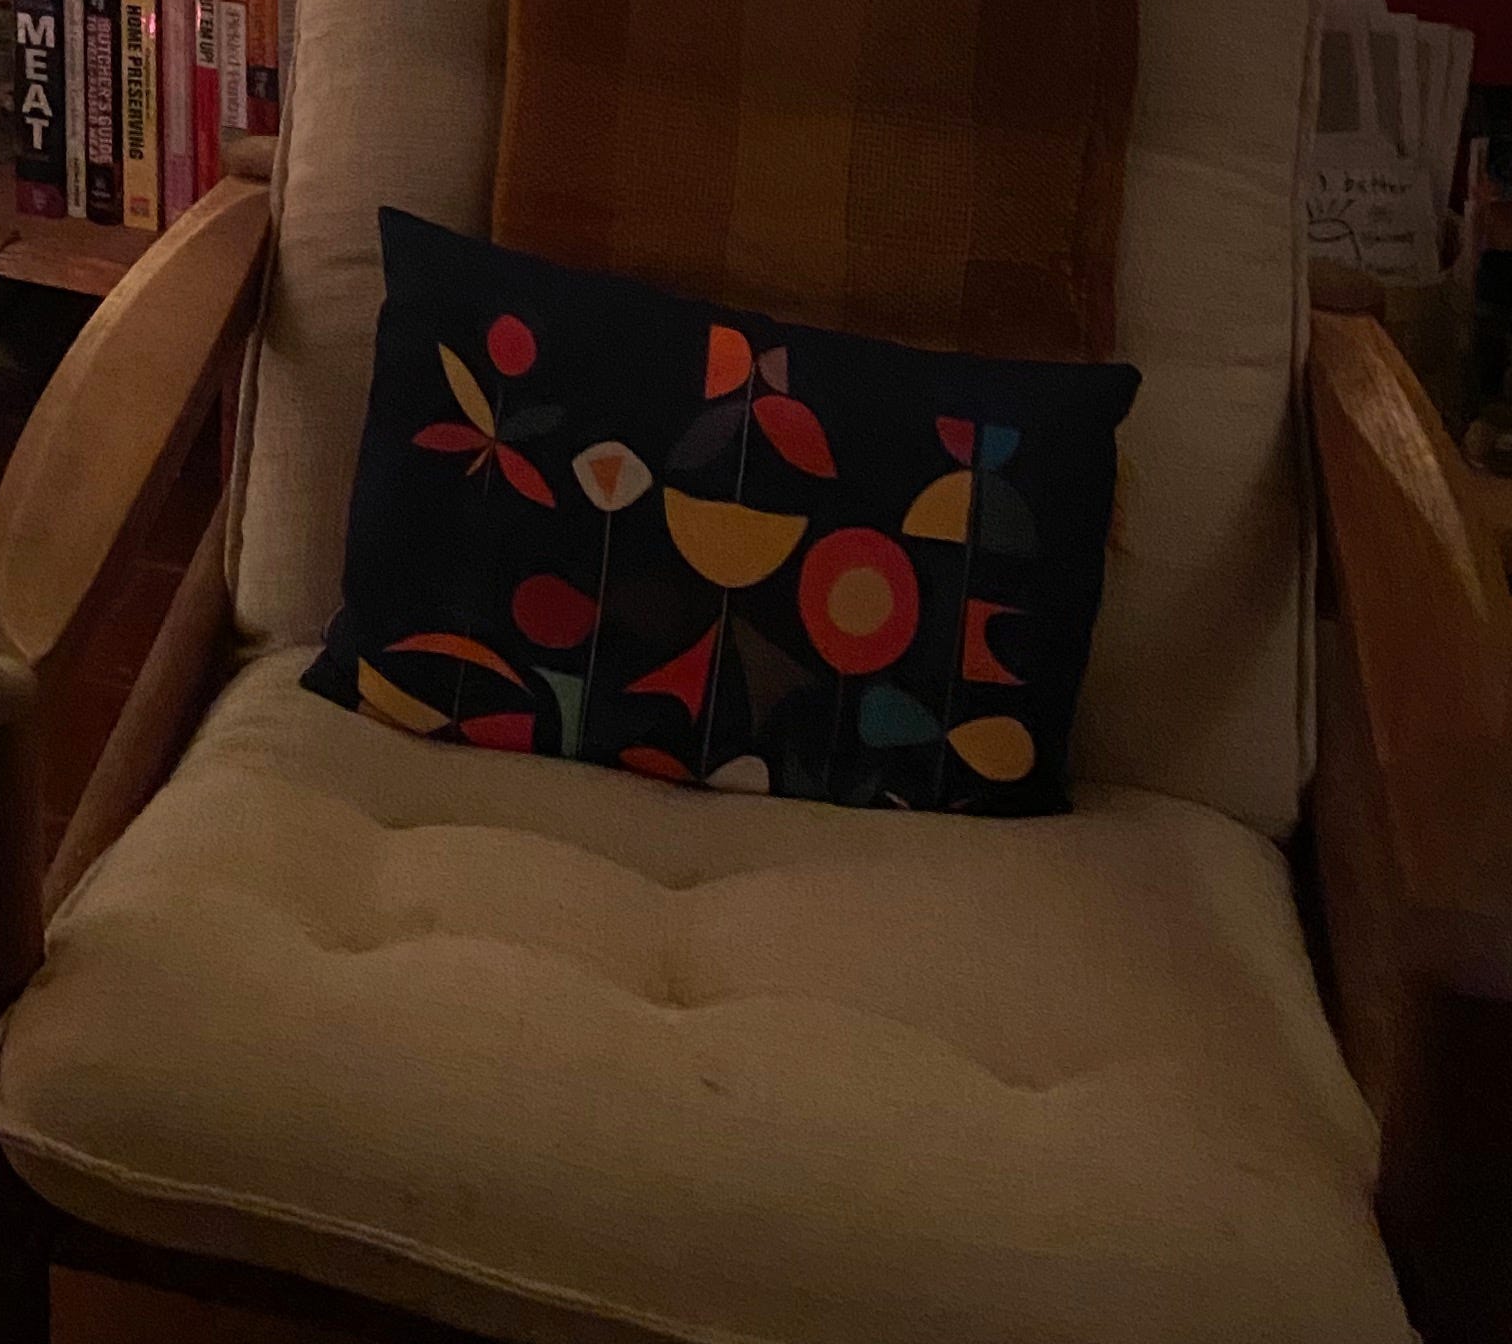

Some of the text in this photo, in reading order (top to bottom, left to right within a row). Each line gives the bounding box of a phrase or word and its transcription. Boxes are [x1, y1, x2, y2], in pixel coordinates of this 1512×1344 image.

[16, 11, 56, 151] MEAT
[127, 4, 145, 160] HOME PRESERVING
